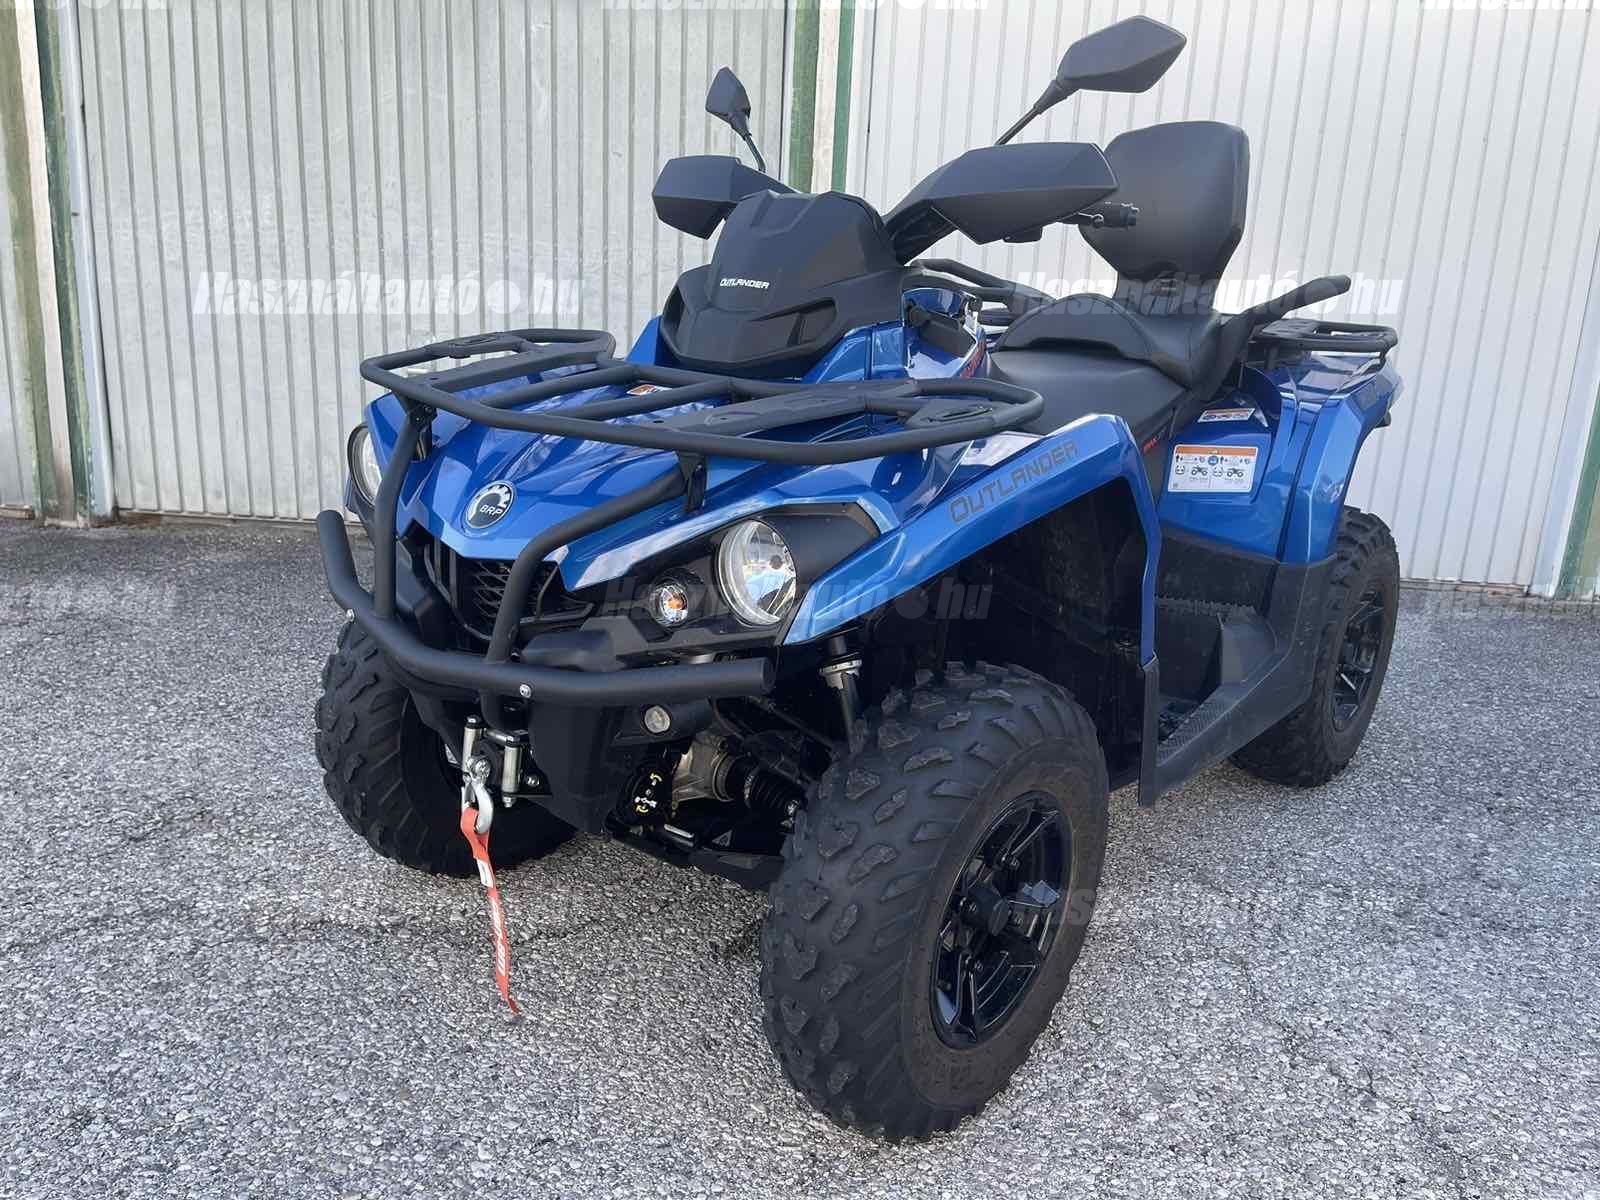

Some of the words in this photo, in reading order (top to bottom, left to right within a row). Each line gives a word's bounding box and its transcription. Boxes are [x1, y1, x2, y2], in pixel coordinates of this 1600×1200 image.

[720, 278, 770, 289] OUTLANDER
[951, 439, 1079, 523] OUTLANDER
[480, 504, 503, 515] BRP
